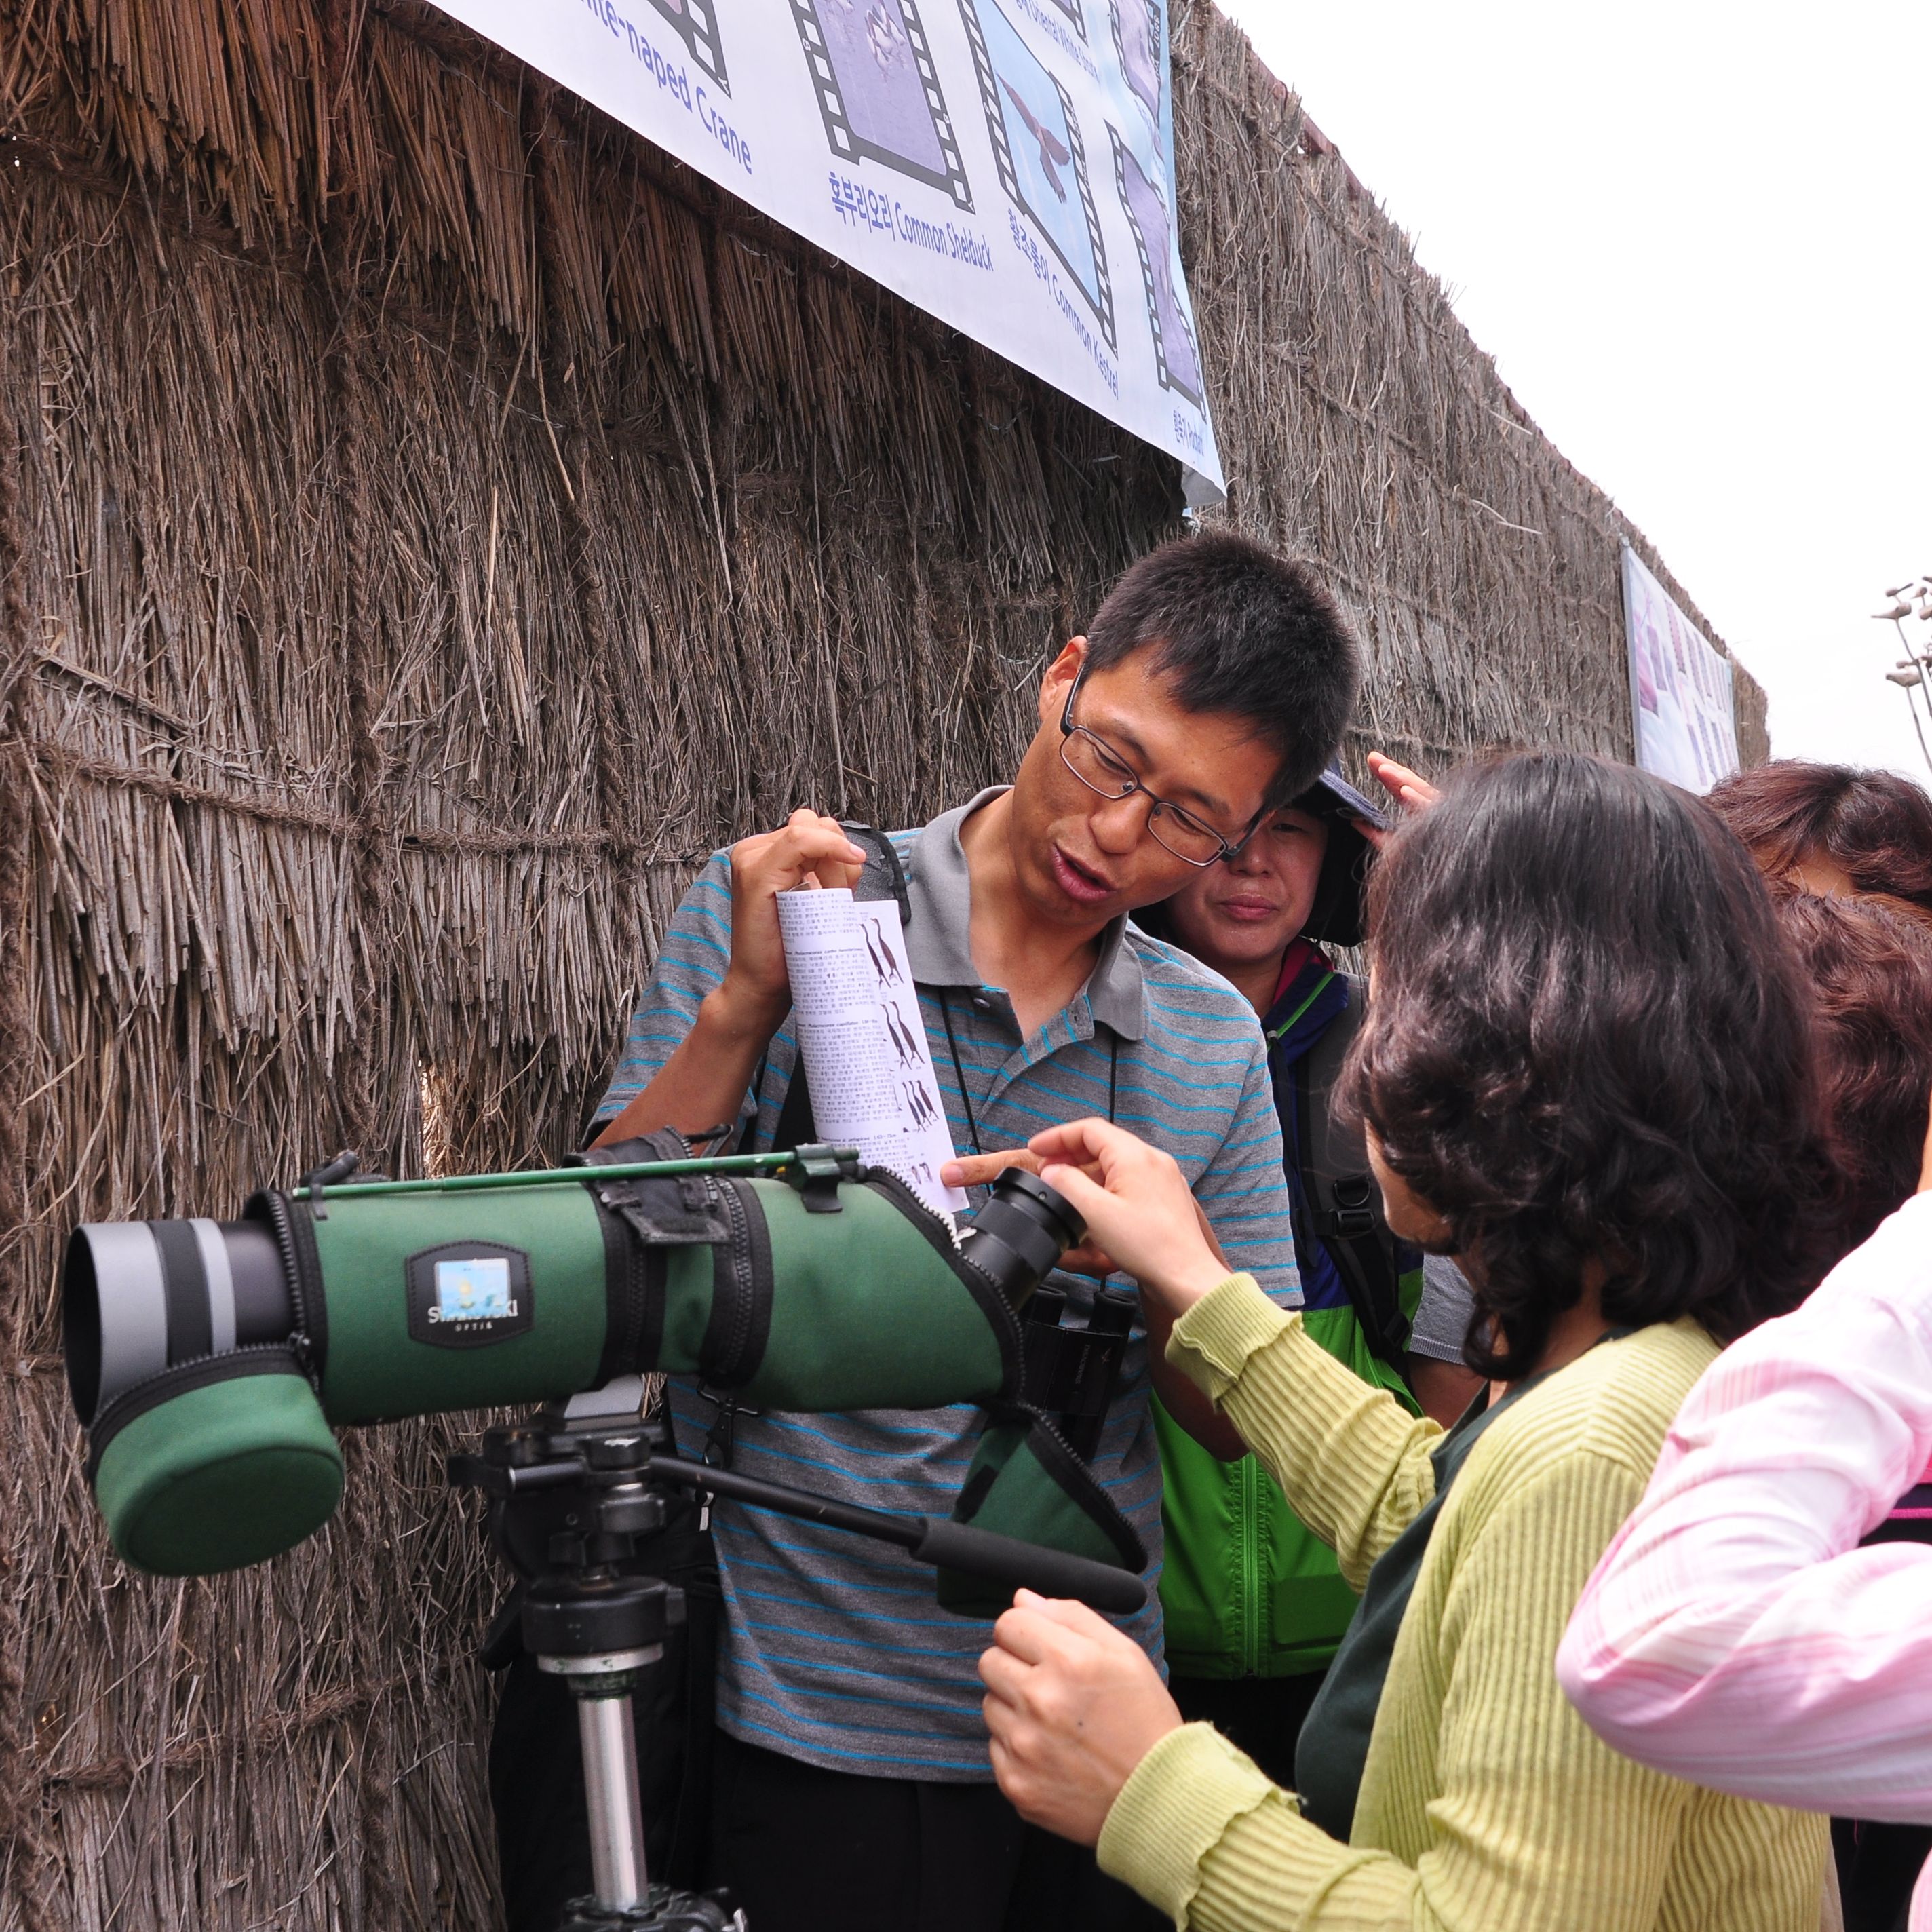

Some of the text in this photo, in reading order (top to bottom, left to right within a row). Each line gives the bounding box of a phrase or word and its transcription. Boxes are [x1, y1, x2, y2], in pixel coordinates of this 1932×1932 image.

[696, 85, 752, 175] Crane
[829, 171, 994, 271] 혹부리오리 Common Shelduck
[1008, 207, 1119, 401] 황조롱이 Common Kestrel
